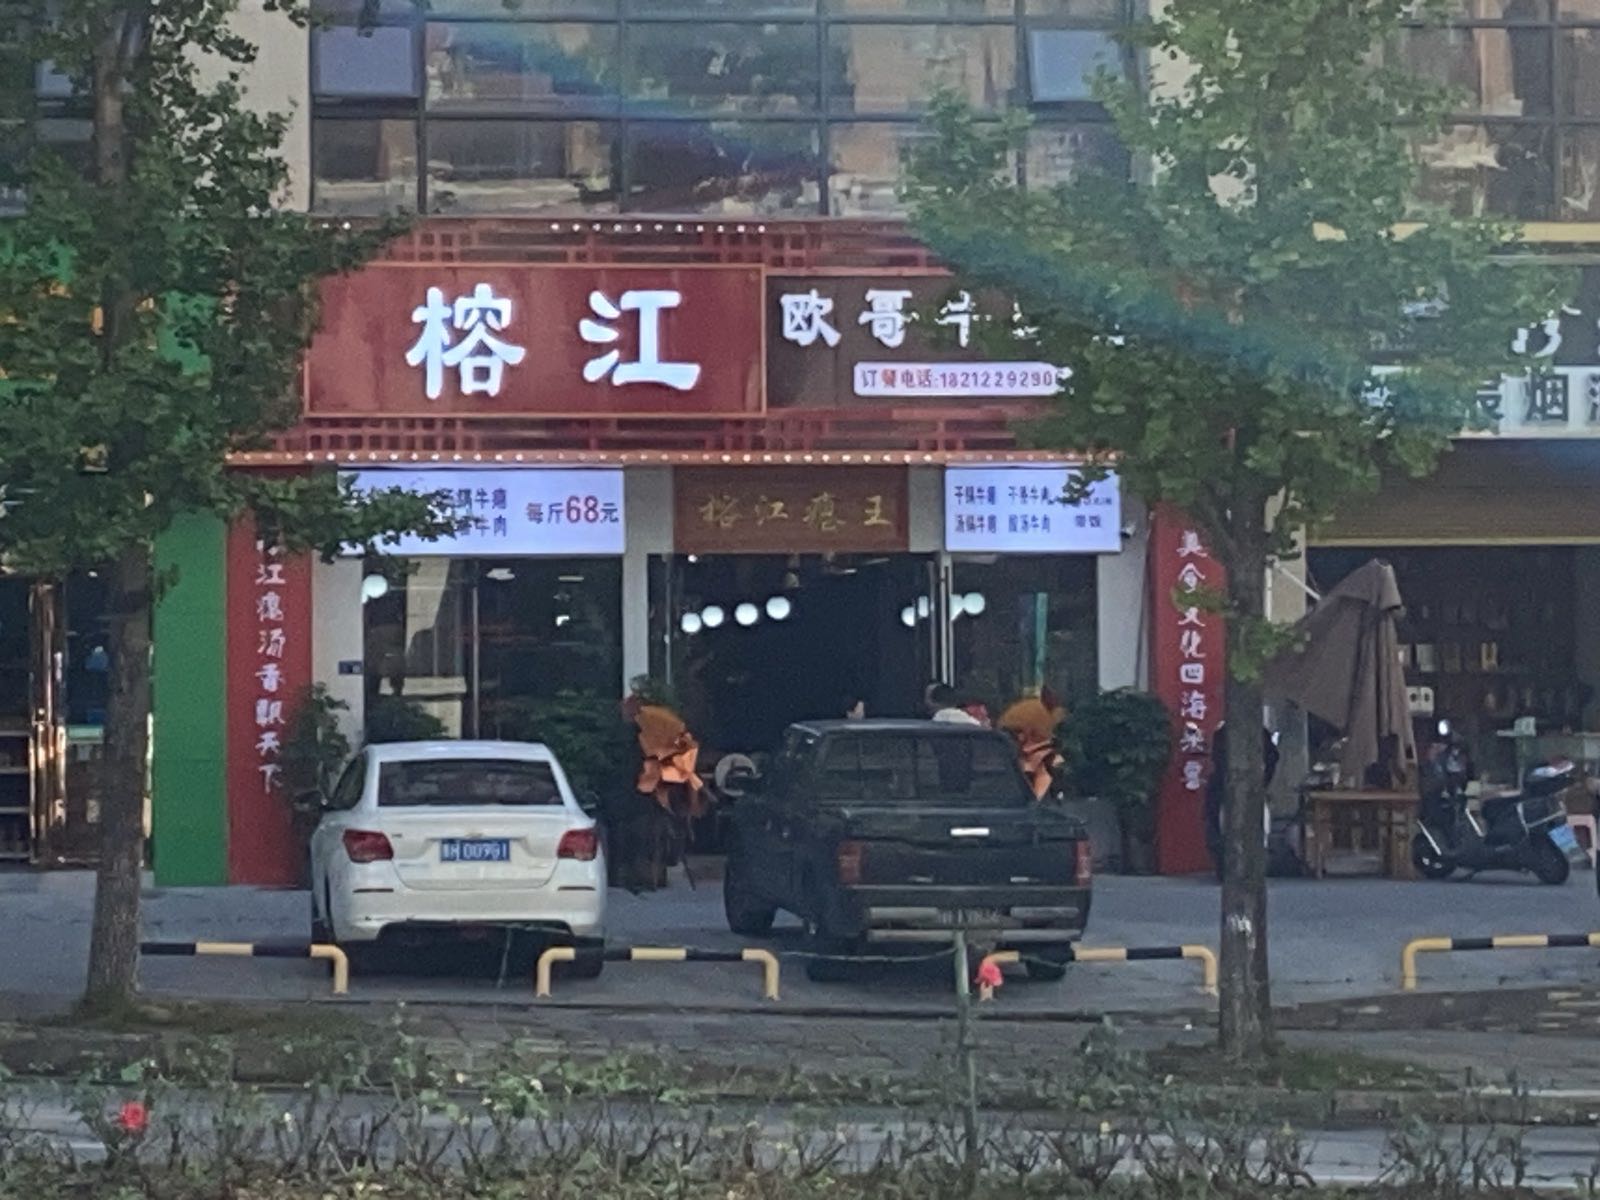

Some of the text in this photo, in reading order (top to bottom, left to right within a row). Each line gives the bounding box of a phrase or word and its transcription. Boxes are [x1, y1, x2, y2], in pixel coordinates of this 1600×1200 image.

[405, 283, 700, 399] 榕江
[526, 496, 619, 525] 每斤68元
[255, 539, 286, 793] 江瘪汤香飘天下
